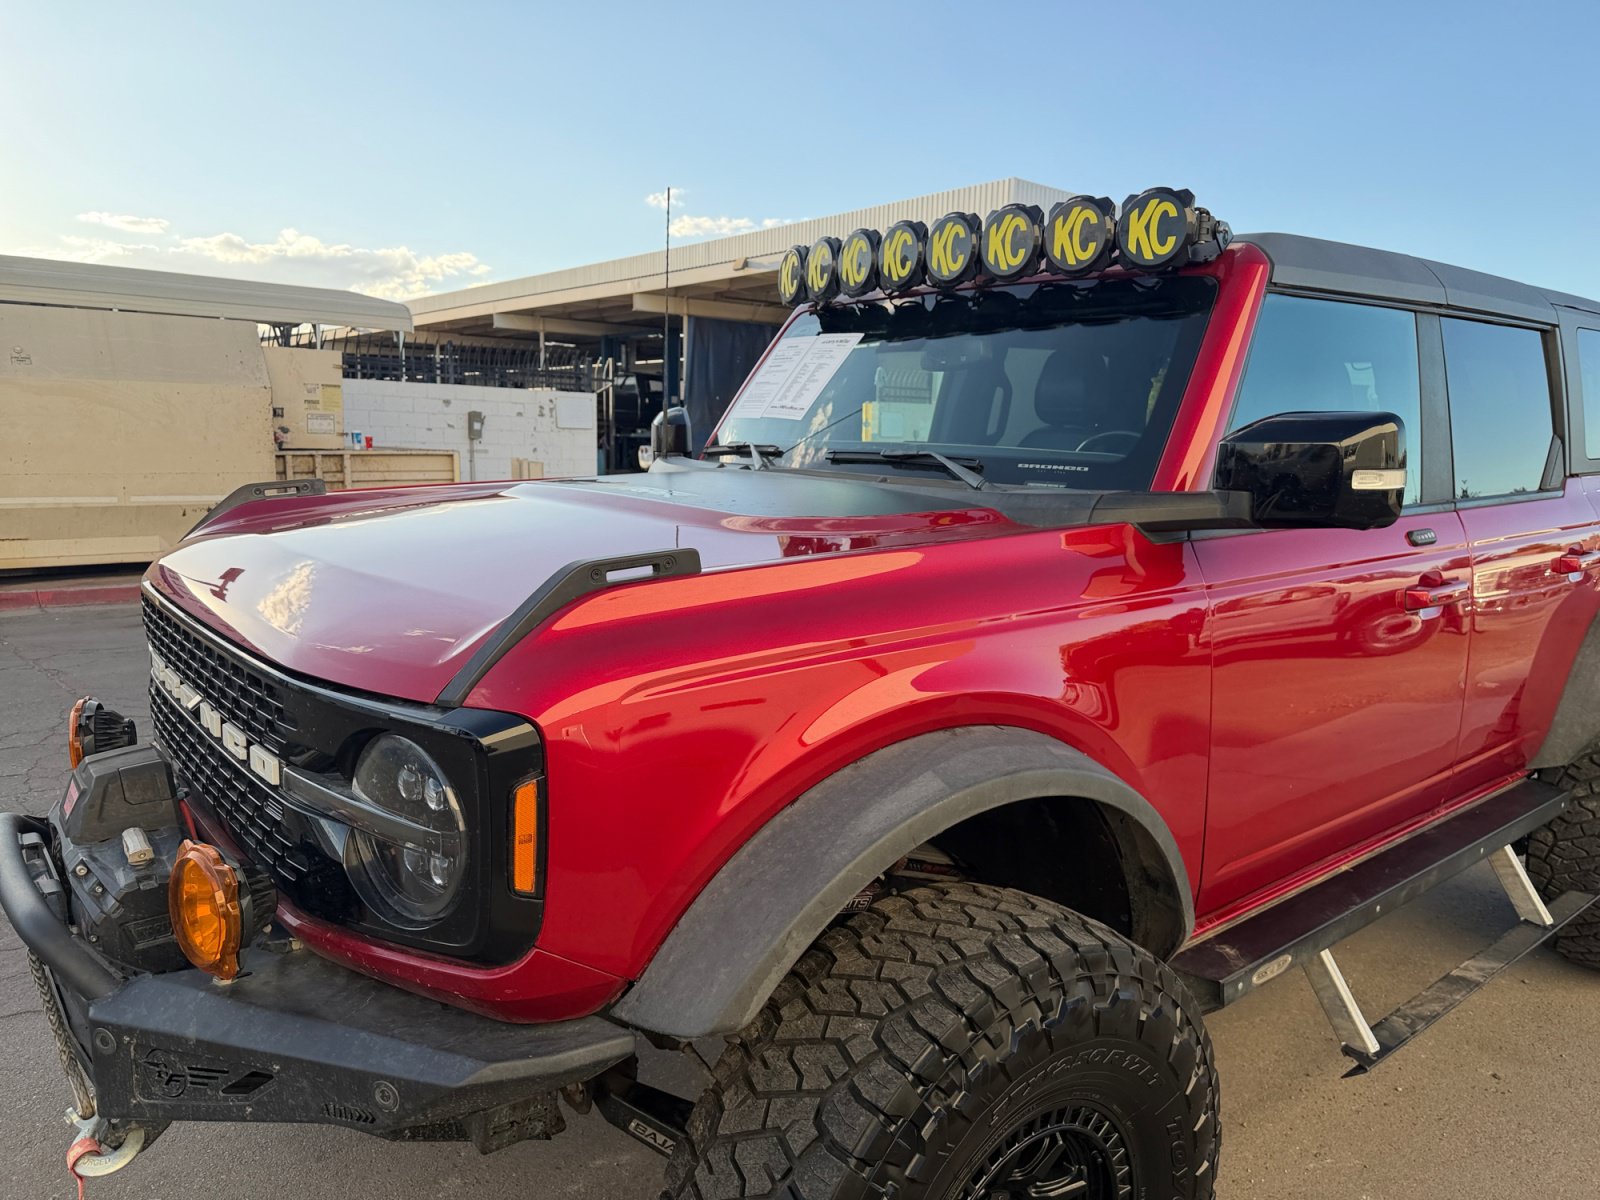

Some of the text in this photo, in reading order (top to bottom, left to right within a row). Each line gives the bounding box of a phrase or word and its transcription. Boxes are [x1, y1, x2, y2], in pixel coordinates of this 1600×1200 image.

[883, 229, 913, 279] KC
[931, 222, 965, 276] KC
[988, 213, 1027, 271] KC
[1053, 206, 1097, 265] KC
[1127, 198, 1178, 261] KC
[780, 250, 799, 299] KC
[807, 244, 829, 288] KC
[841, 238, 867, 288] KC
[1166, 1115, 1188, 1200] TOY
